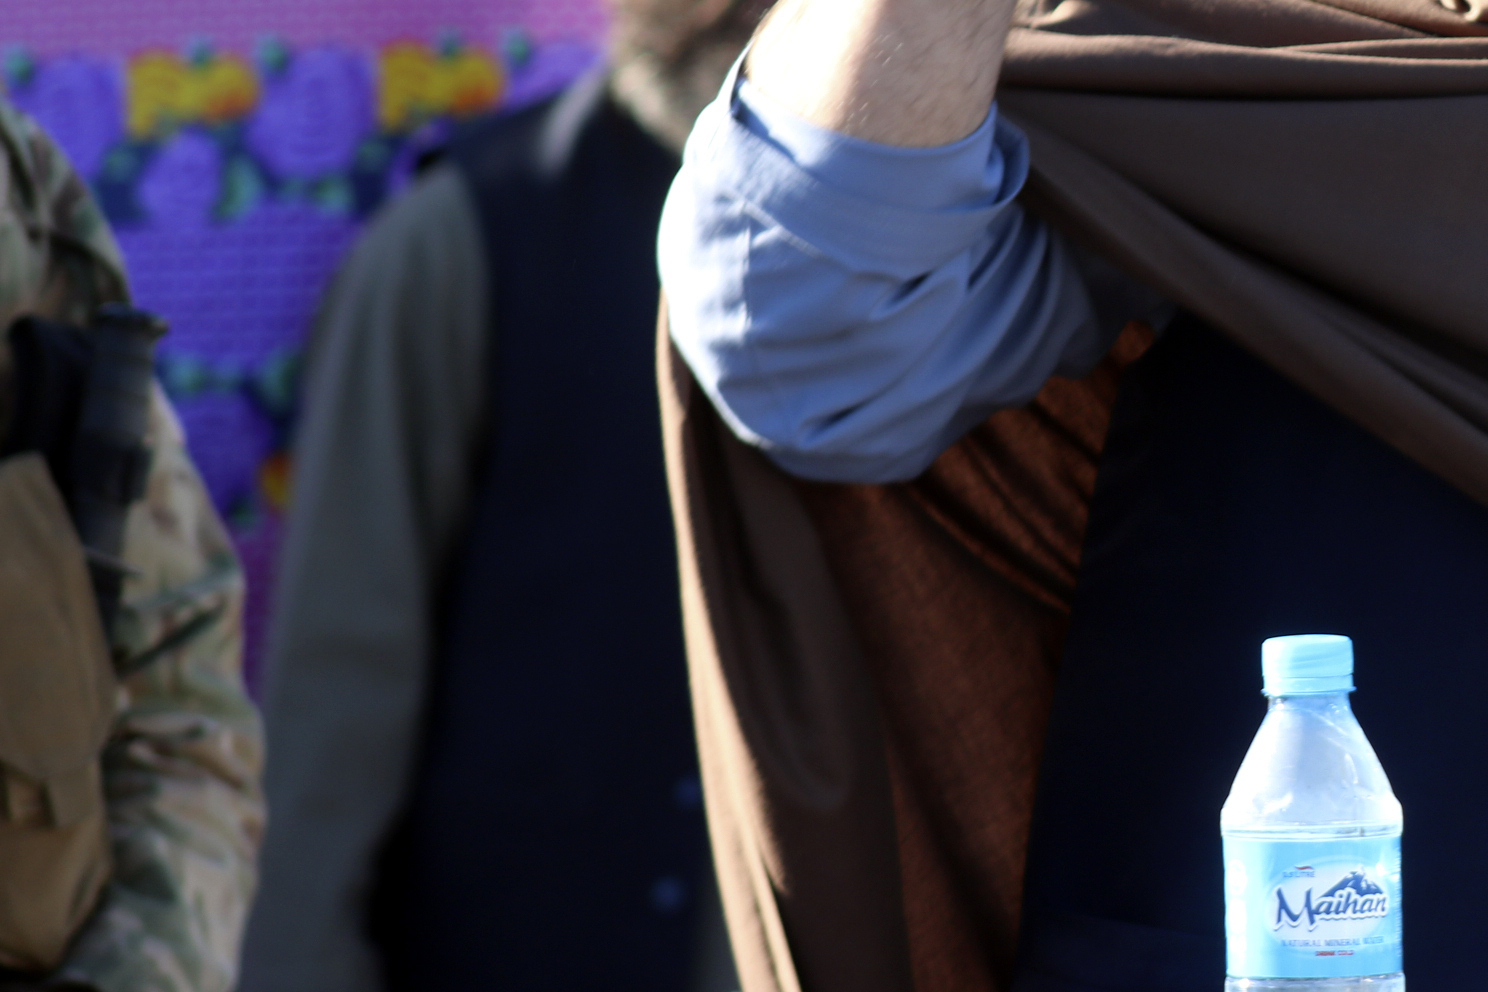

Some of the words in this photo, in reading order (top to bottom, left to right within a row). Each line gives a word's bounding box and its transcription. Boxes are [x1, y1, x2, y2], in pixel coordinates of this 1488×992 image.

[1275, 886, 1387, 926] Maihan
[1281, 939, 1322, 947] NATURAL
[1324, 938, 1361, 946] MINERAL
